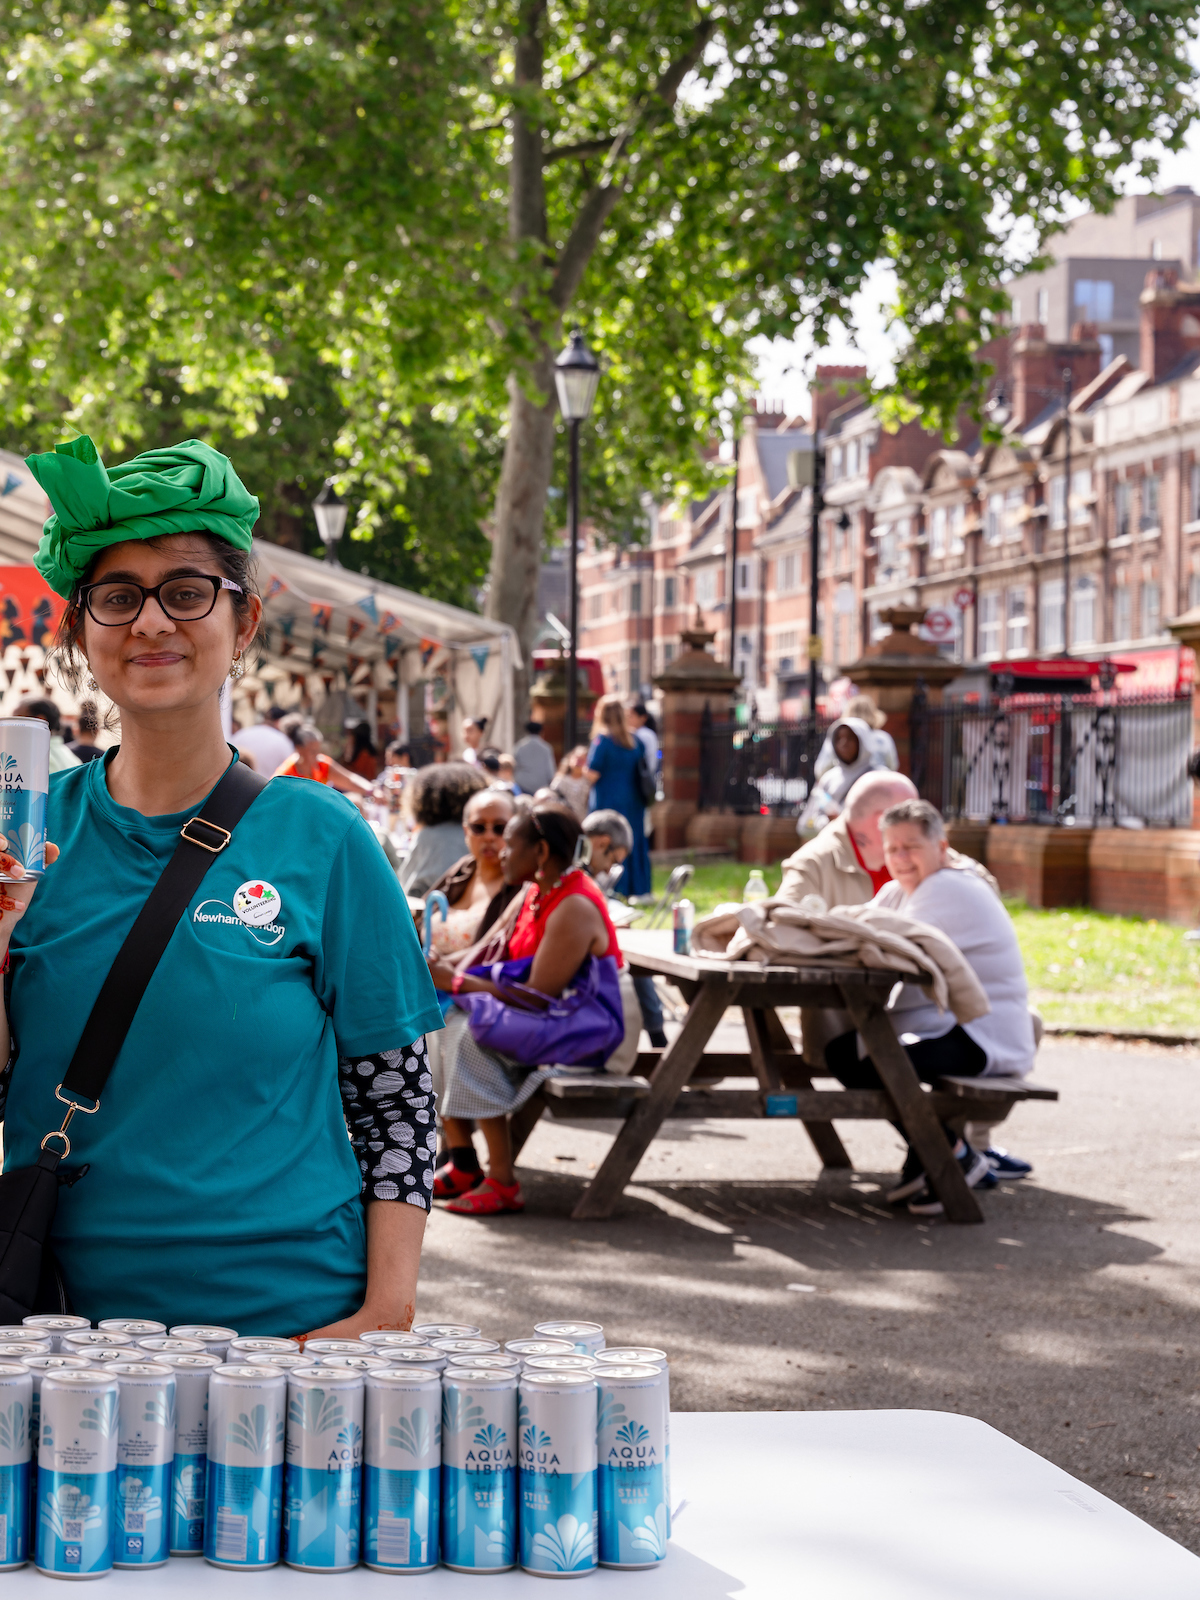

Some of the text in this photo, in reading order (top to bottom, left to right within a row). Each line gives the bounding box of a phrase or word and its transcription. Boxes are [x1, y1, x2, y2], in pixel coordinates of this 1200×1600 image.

[242, 897, 277, 914] VOLUNTEERING
[193, 912, 242, 926] Newham
[466, 1449, 512, 1462] AQUA
[519, 1449, 560, 1465] AQUA
[608, 1446, 657, 1459] AQUA
[465, 1463, 513, 1475] LIBRA
[608, 1460, 657, 1473] LIBRA
[474, 1492, 505, 1501] STILL
[523, 1491, 551, 1504] STILL
[618, 1488, 650, 1498] STILL
